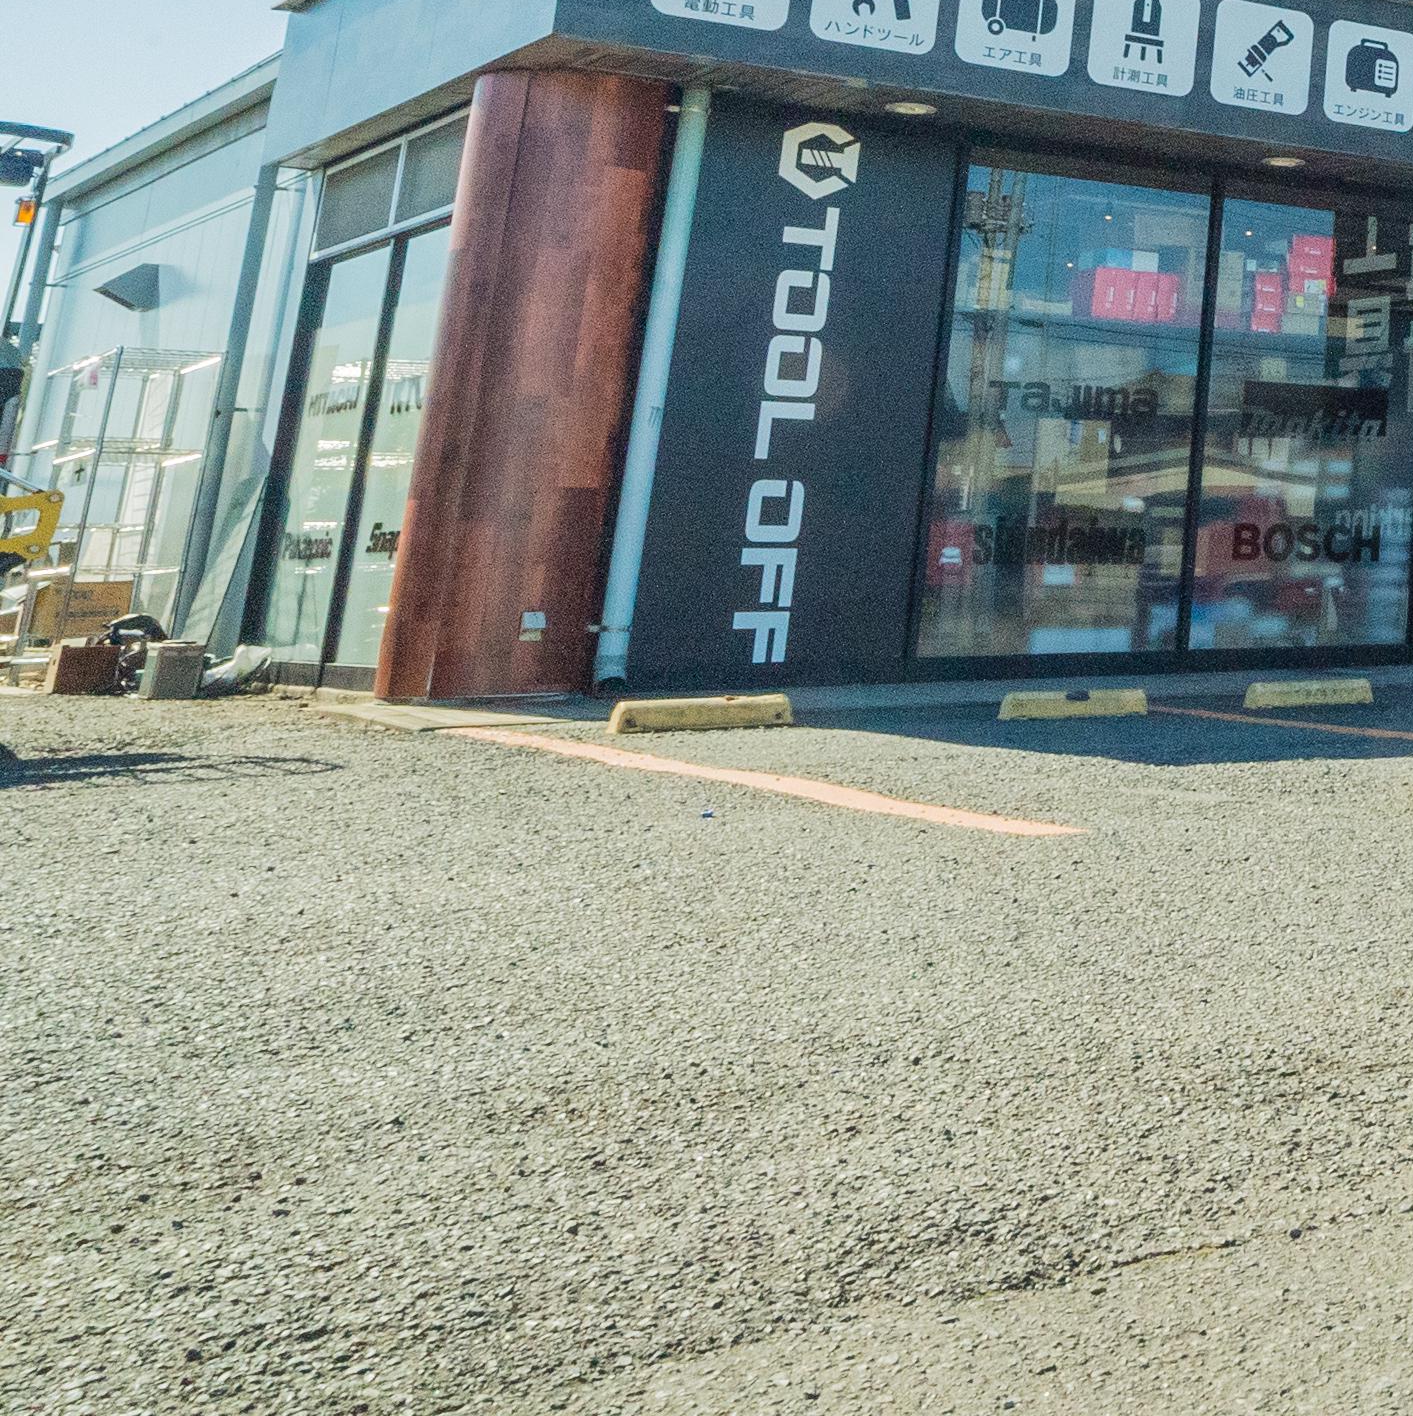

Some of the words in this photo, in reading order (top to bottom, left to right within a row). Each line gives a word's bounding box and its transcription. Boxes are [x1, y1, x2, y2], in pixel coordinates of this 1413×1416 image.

[824, 18, 925, 48] ハンドツール
[982, 44, 1042, 68] エア工具
[1113, 65, 1168, 89] 計測工具
[1233, 85, 1284, 107] 油圧工具
[1333, 103, 1405, 127] エンジン工具
[754, 207, 839, 460] TOOL
[1231, 523, 1382, 562] BOSCH
[733, 480, 805, 663] OFF
